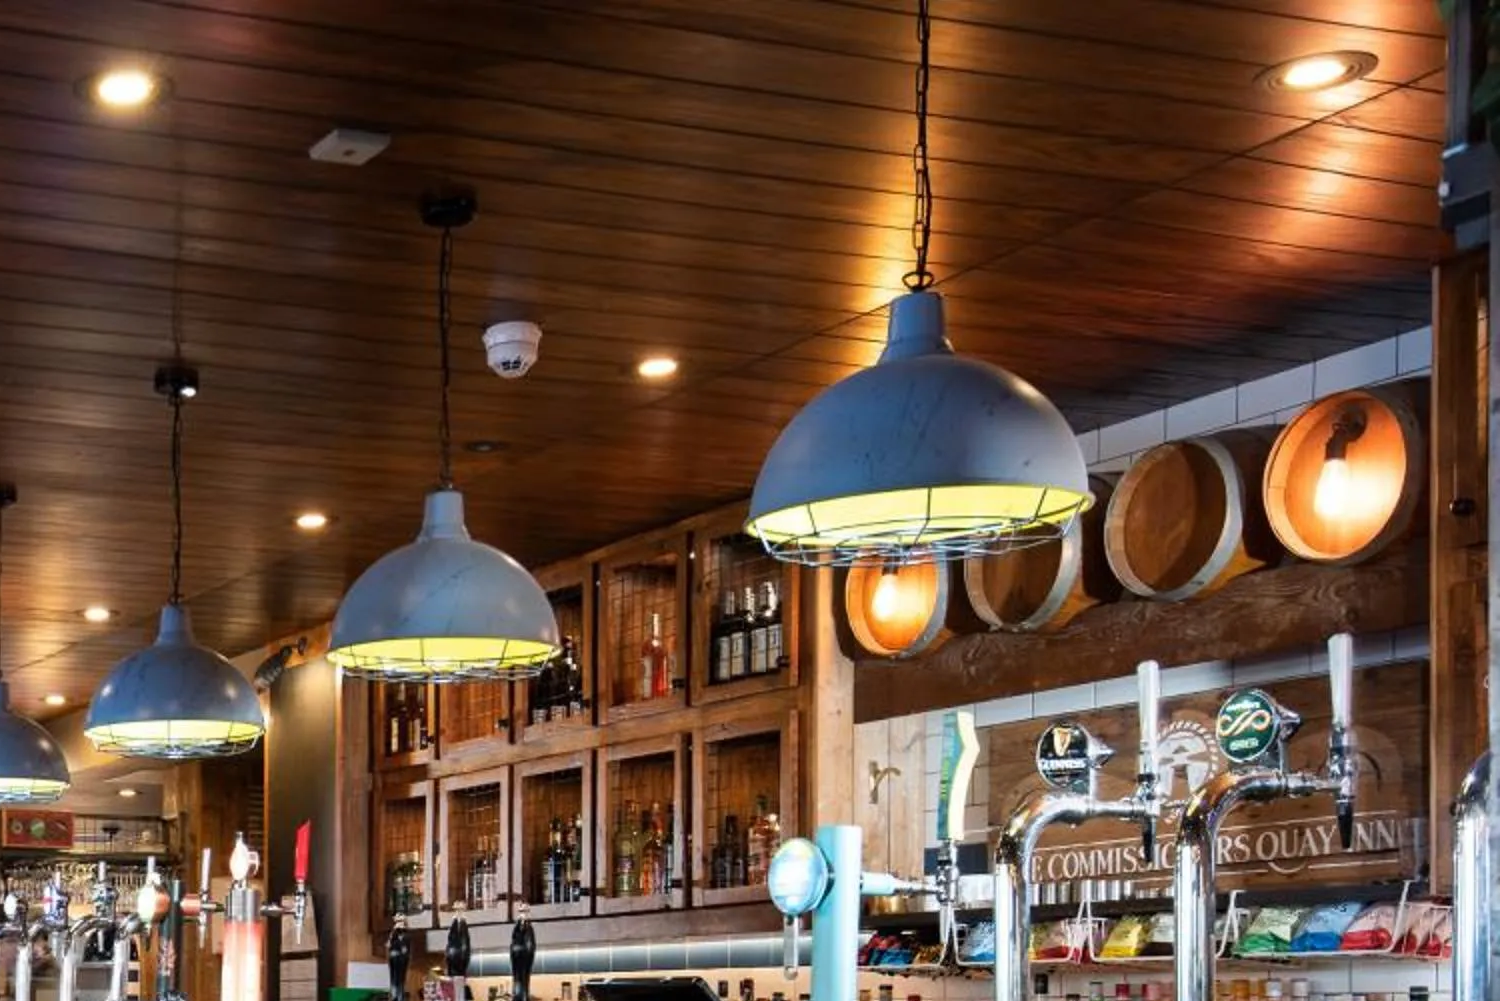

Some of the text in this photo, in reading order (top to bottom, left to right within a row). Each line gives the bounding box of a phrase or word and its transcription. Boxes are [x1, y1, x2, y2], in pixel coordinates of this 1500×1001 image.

[1047, 833, 1250, 881] COMMISSIORS
[1255, 824, 1337, 873] QUAY
[1350, 819, 1396, 852] NN
